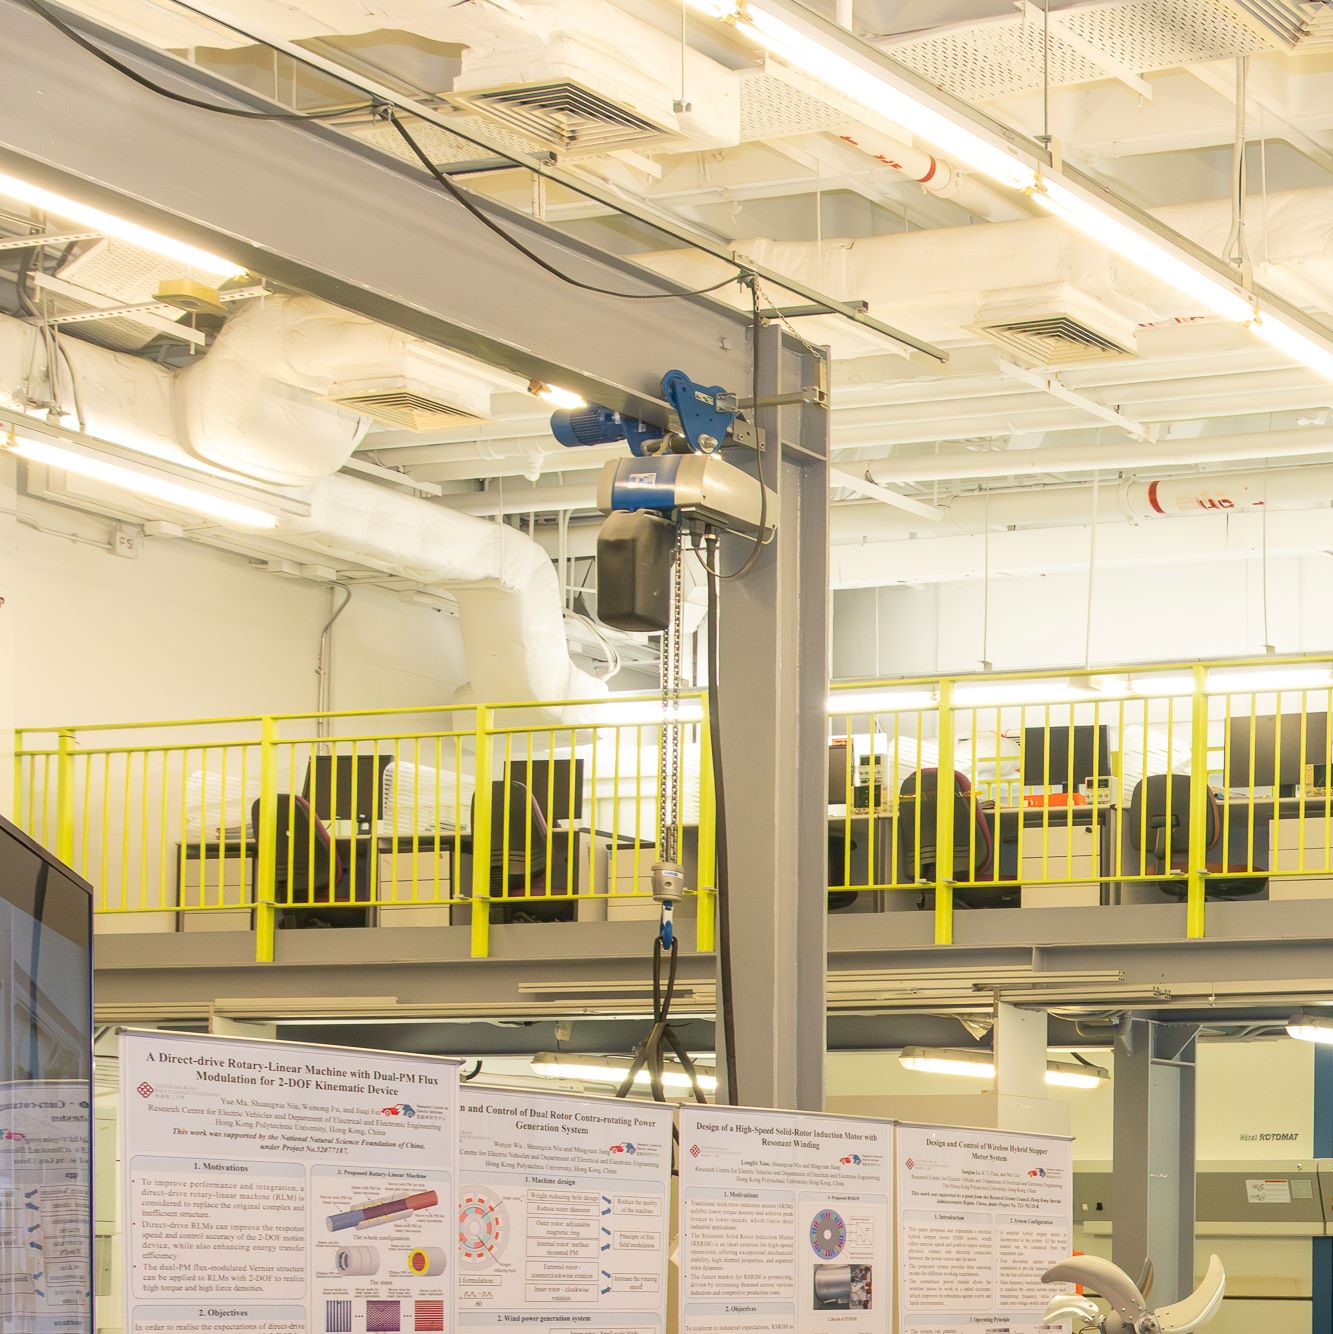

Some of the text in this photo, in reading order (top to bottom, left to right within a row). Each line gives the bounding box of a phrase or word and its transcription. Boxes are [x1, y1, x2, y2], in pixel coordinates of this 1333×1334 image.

[146, 1052, 438, 1085] A Direct-drive Rotary-Linear Machine with Dual-PM Flux
[196, 1071, 399, 1096] Modulation for 2-DOF Kinematic Device
[468, 1105, 484, 1113] and
[486, 1105, 518, 1116] Control
[519, 1108, 529, 1117] of
[530, 1109, 548, 1118] Dual
[550, 1110, 573, 1120] Rotor
[574, 1113, 632, 1127] Contra-rotating
[634, 1118, 656, 1127] Power
[515, 1121, 589, 1135] Generation System
[697, 1122, 720, 1132] Design
[721, 1124, 729, 1132] of
[736, 1125, 774, 1136] High-Speed
[775, 1128, 812, 1137] Solid-Rotor
[814, 1130, 843, 1139] Induction
[844, 1132, 863, 1140] Motor
[256, 1133, 266, 1141] by
[335, 1138, 359, 1146] Science
[1259, 1133, 1299, 1141] ROTOMAT
[762, 1138, 820, 1150] Resonant Winding
[926, 1138, 946, 1148] Design
[958, 1141, 980, 1149] Control
[987, 1143, 1009, 1151] Wireless
[1010, 1145, 1028, 1153] Hybrid
[1029, 1147, 1048, 1156] Stepper
[972, 1152, 1008, 1163] Motor System
[194, 1162, 249, 1172] 1. Motivations
[142, 1178, 188, 1188] To improve
[557, 1178, 576, 1186] design
[141, 1189, 188, 1197] direct-drive
[142, 1221, 189, 1229] Direct-drive
[199, 1309, 248, 1318] 2. Objectives
[540, 1315, 571, 1323] generation
